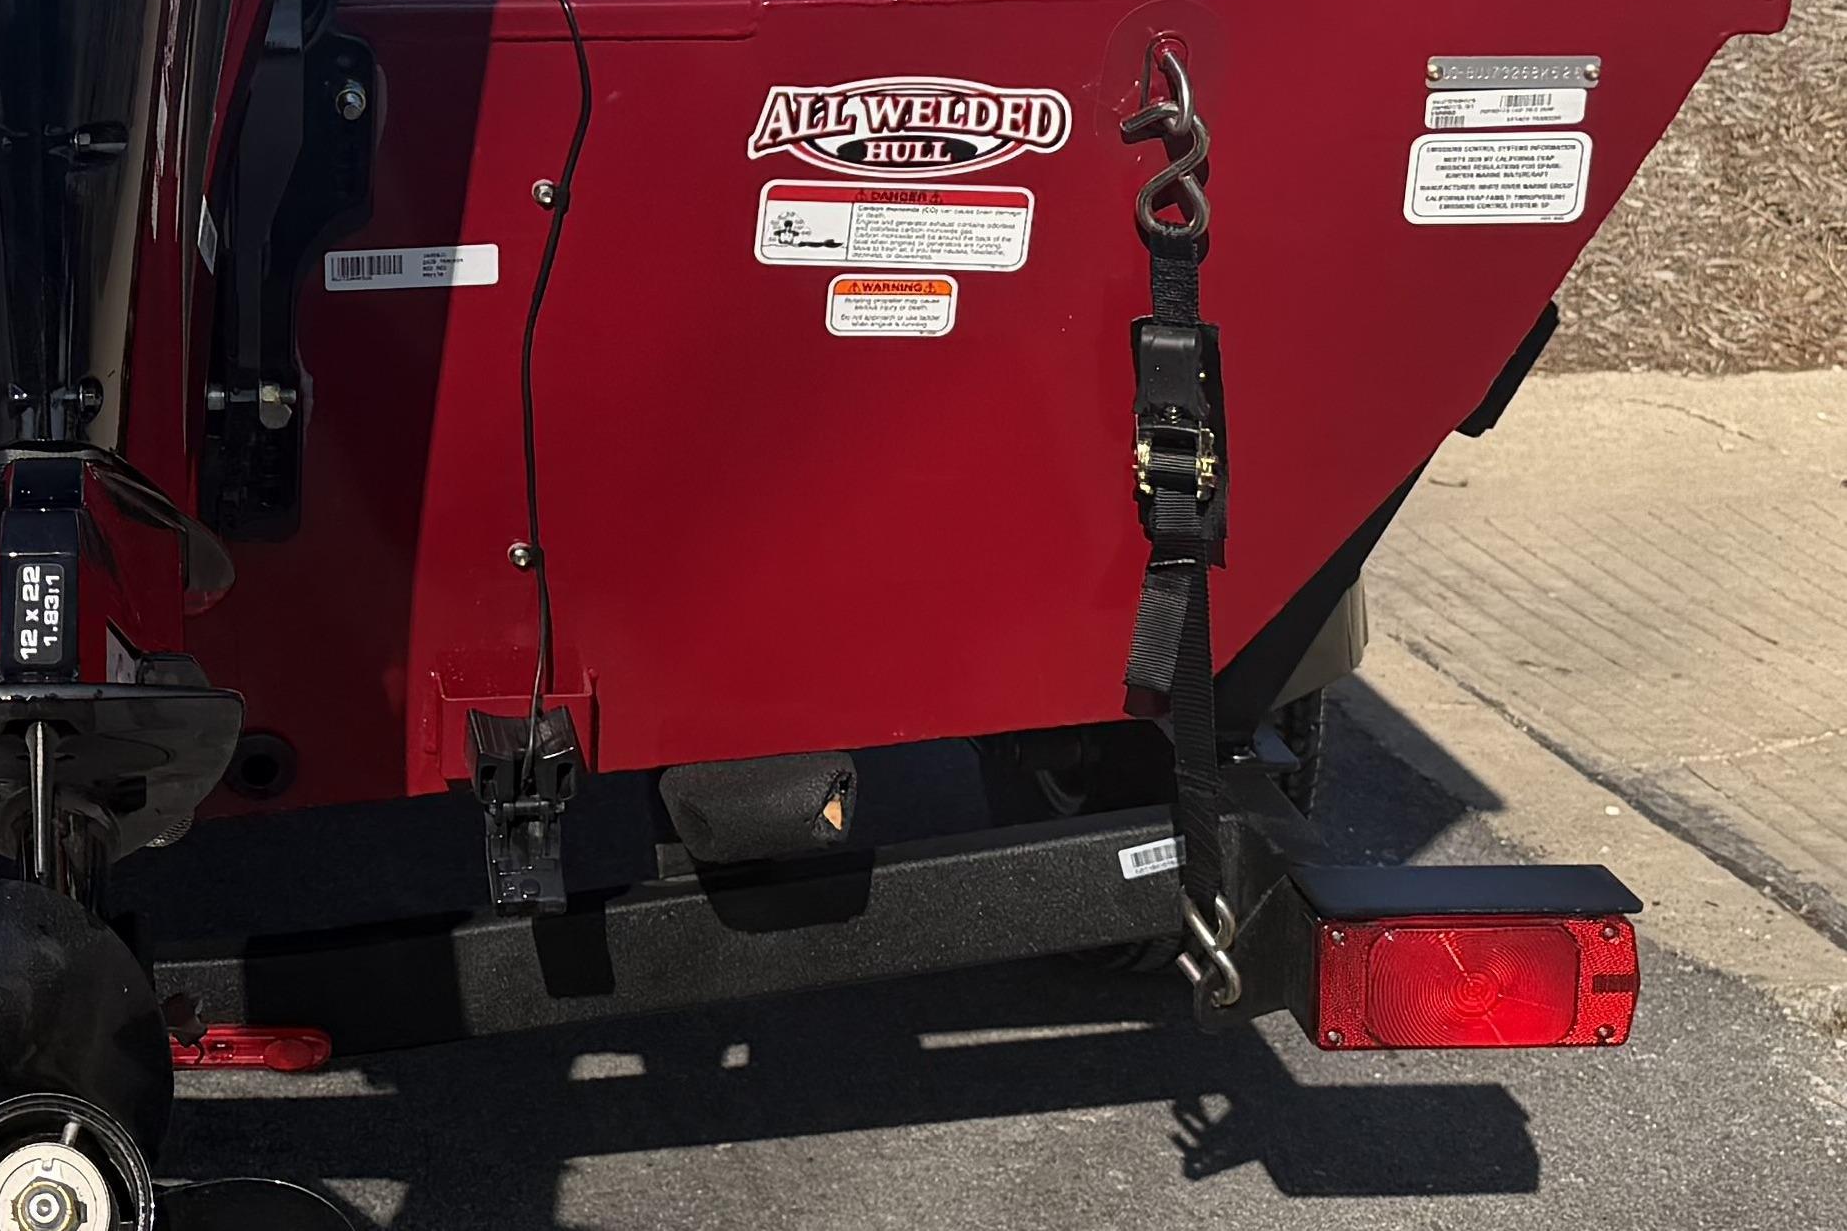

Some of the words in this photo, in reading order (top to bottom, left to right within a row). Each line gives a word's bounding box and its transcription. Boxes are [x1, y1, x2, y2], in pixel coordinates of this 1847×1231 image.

[753, 93, 857, 148] ALL
[861, 93, 1065, 148] WELDED
[863, 141, 953, 162] HULL
[871, 191, 928, 202] DANGER
[861, 282, 923, 293] WARNING
[22, 566, 41, 601] 22
[25, 609, 40, 622] x
[43, 575, 61, 647] 1.83:1
[20, 629, 38, 660] 12
